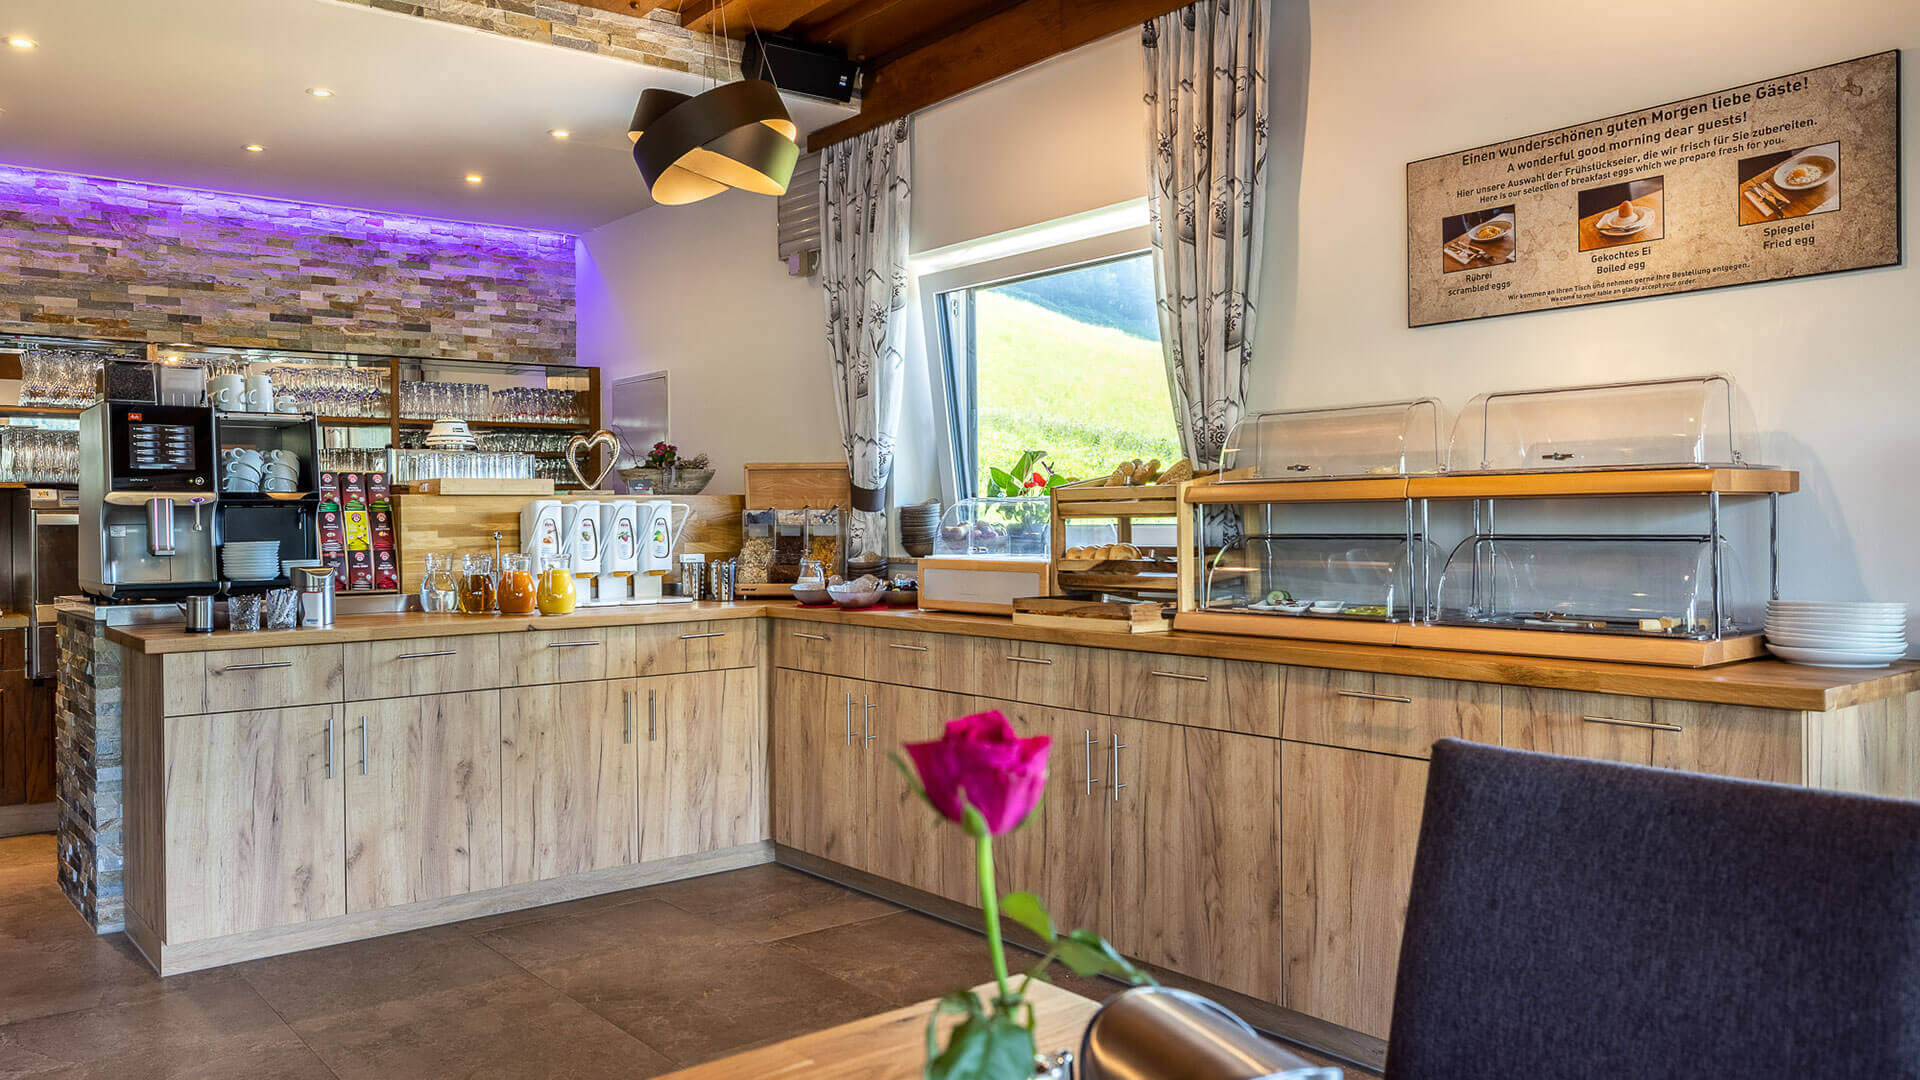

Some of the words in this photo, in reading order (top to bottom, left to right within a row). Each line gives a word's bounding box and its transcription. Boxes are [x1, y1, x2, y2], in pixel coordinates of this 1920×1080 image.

[1462, 151, 1495, 166] Einen
[1499, 128, 1603, 157] wunderschönen
[1607, 117, 1647, 137] guten
[1652, 103, 1708, 124] Morgen
[1713, 93, 1751, 110] liebe
[1756, 76, 1809, 99] Gäste!
[1507, 163, 1515, 173] A
[1517, 149, 1575, 171] wonderful
[1578, 143, 1606, 160] good
[1609, 132, 1661, 151] morning
[1664, 125, 1694, 139] dear
[1698, 111, 1747, 134] guests!
[1456, 189, 1474, 198] Hier
[1476, 182, 1506, 195] unsere
[1507, 173, 1545, 188] Auswahl
[1547, 170, 1563, 180] der
[1565, 155, 1641, 176] Frühstückseier,
[1643, 150, 1659, 160] die
[1661, 146, 1678, 156] wir
[1680, 139, 1711, 153] frisch
[1713, 135, 1729, 146] für
[1732, 131, 1750, 142] Sie
[1752, 118, 1818, 138] zubereiten.
[1480, 195, 1498, 204] Here
[1508, 189, 1521, 197] our
[1523, 181, 1560, 195] selection
[1571, 171, 1611, 185] breakfast
[1613, 167, 1634, 178] eggs
[1635, 160, 1662, 172] which
[1664, 158, 1677, 166] we
[1680, 150, 1716, 165] prepare
[1718, 143, 1744, 156] fresh
[1746, 141, 1761, 150] for
[1763, 137, 1785, 149] you.
[1763, 220, 1815, 238] Spiegelei
[1763, 237, 1792, 250] Fried
[1795, 236, 1815, 247] egg
[1591, 249, 1640, 263] Gekochtes
[1642, 246, 1651, 256] Ei
[1597, 263, 1626, 274] Boiled
[1628, 261, 1646, 271] egg
[1465, 271, 1493, 282] Rührei
[1574, 284, 1592, 292] Tisch
[1606, 278, 1634, 287] nehmen
[1634, 276, 1655, 284] gerne
[1672, 268, 1711, 279] Bestellung
[1448, 282, 1490, 296] scrambled
[1491, 280, 1512, 290] eggs
[1621, 285, 1640, 294] gladly
[1641, 282, 1661, 291] accept
